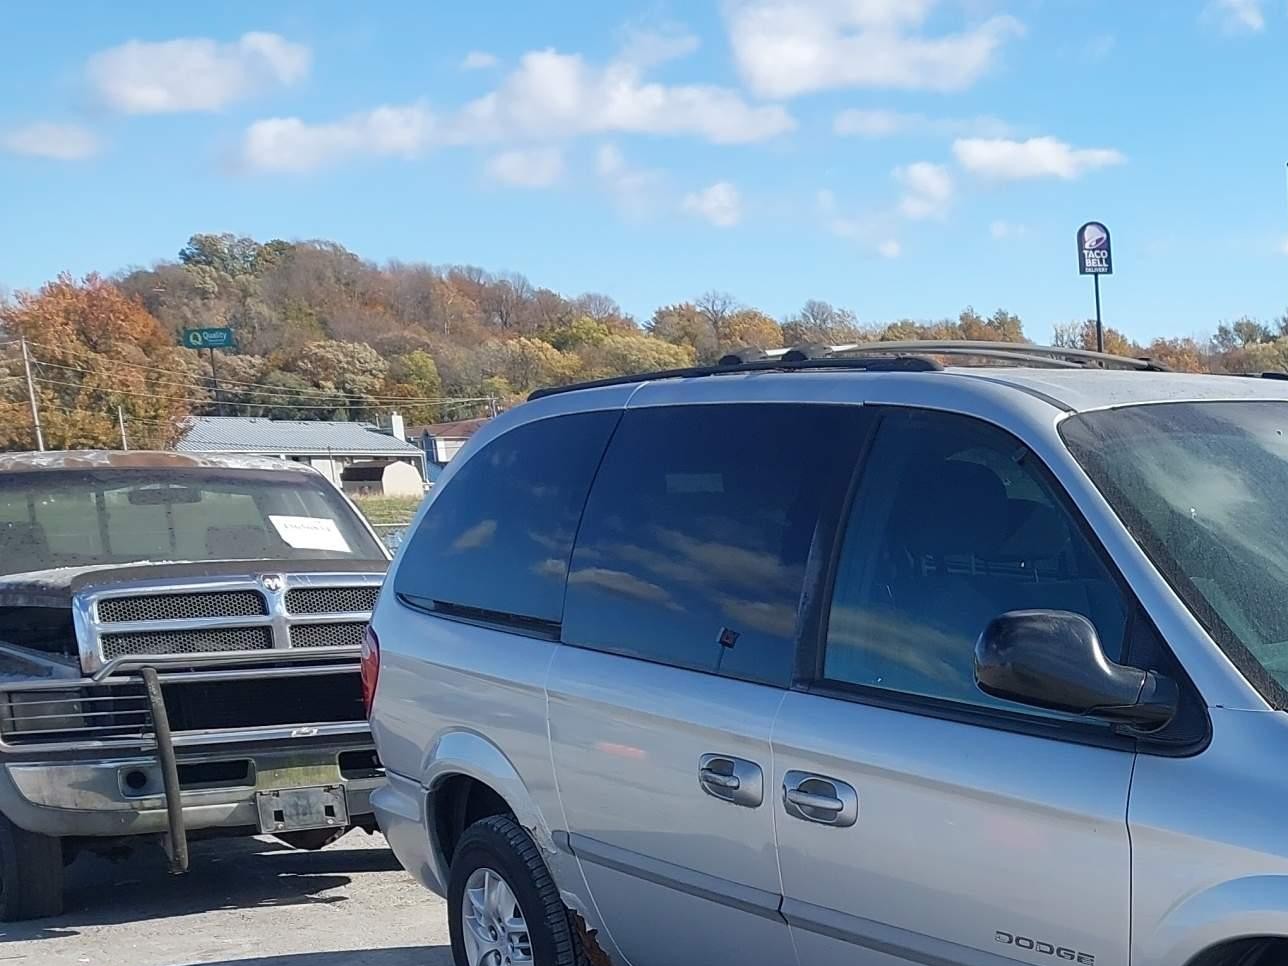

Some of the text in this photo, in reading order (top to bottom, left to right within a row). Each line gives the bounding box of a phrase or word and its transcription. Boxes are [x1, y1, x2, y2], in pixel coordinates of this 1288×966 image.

[1083, 250, 1108, 259] TACO
[1085, 258, 1109, 267] BELL
[202, 331, 227, 340] Quality
[995, 930, 1095, 966] DODGE
